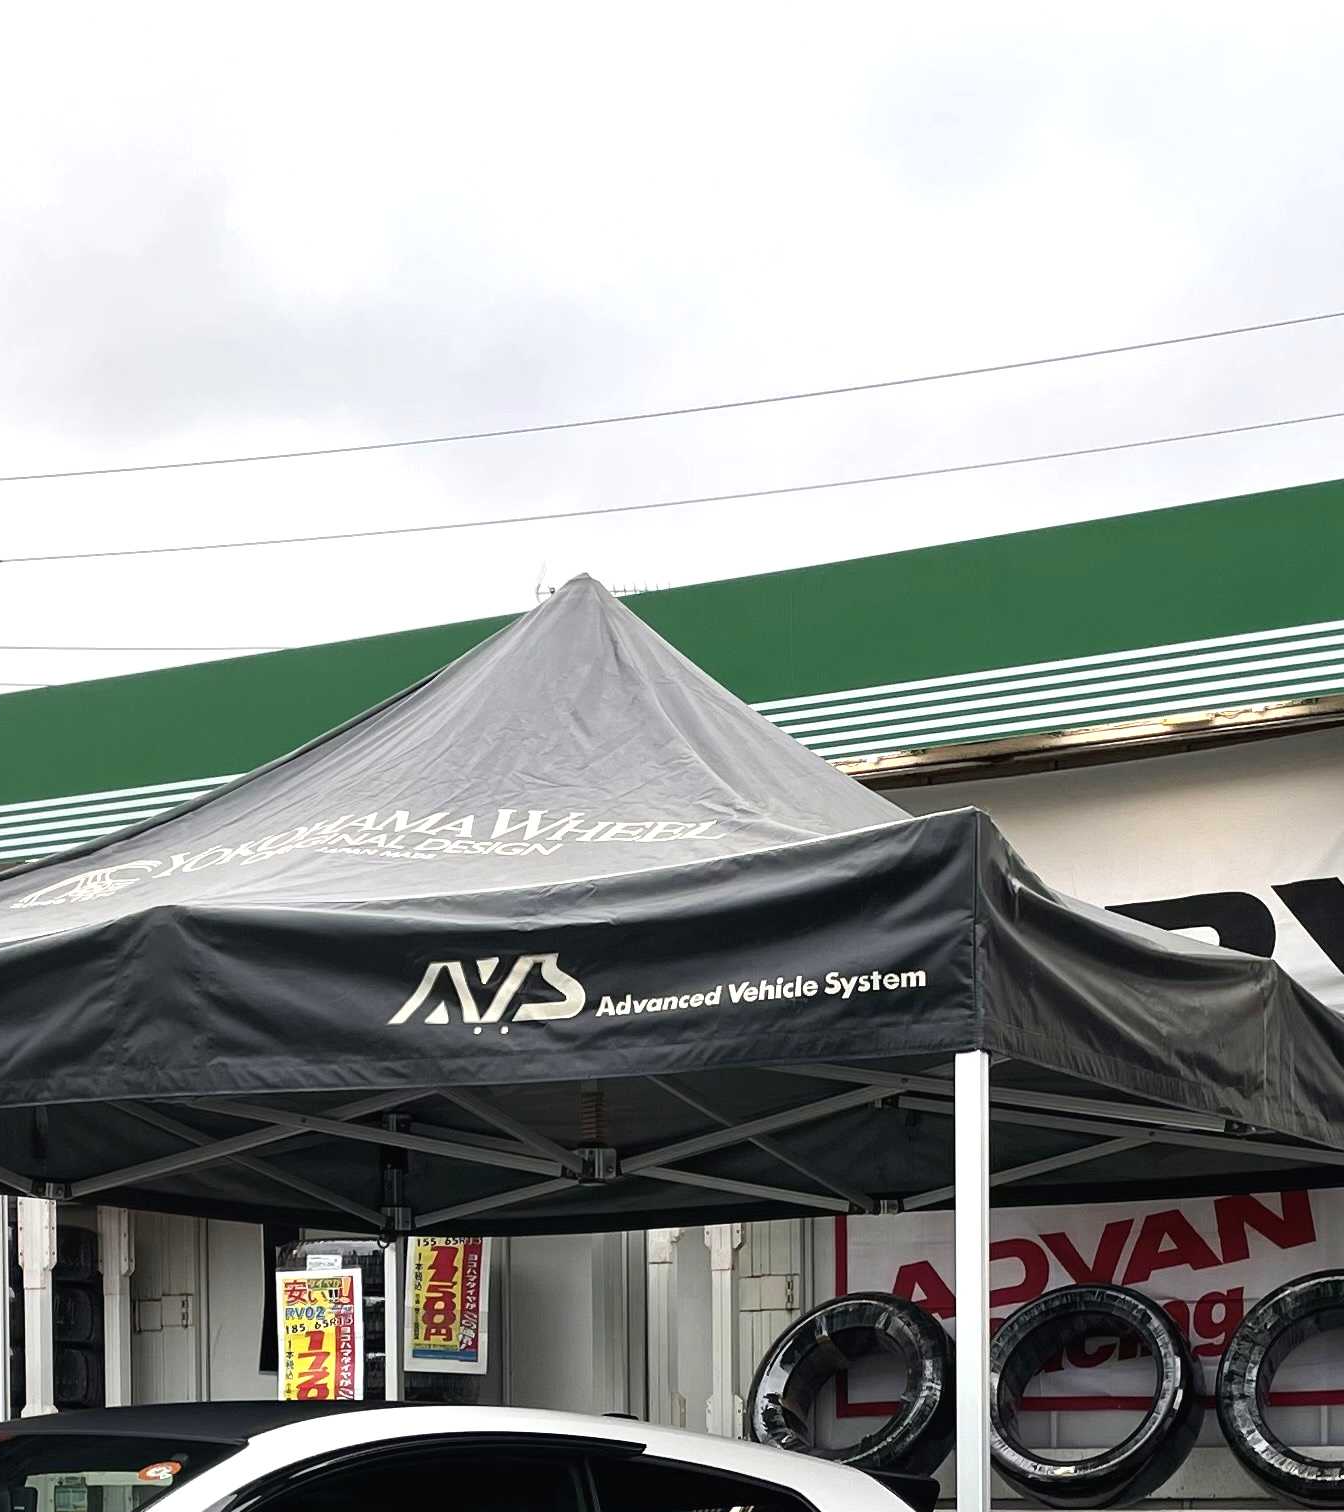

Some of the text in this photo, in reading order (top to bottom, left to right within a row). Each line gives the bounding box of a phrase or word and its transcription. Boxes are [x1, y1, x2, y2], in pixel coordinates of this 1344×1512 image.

[152, 808, 726, 878] YOKOHAMA WHEEL
[420, 838, 564, 857] DESIGN
[594, 968, 928, 1017] Advanced Vehicle System
